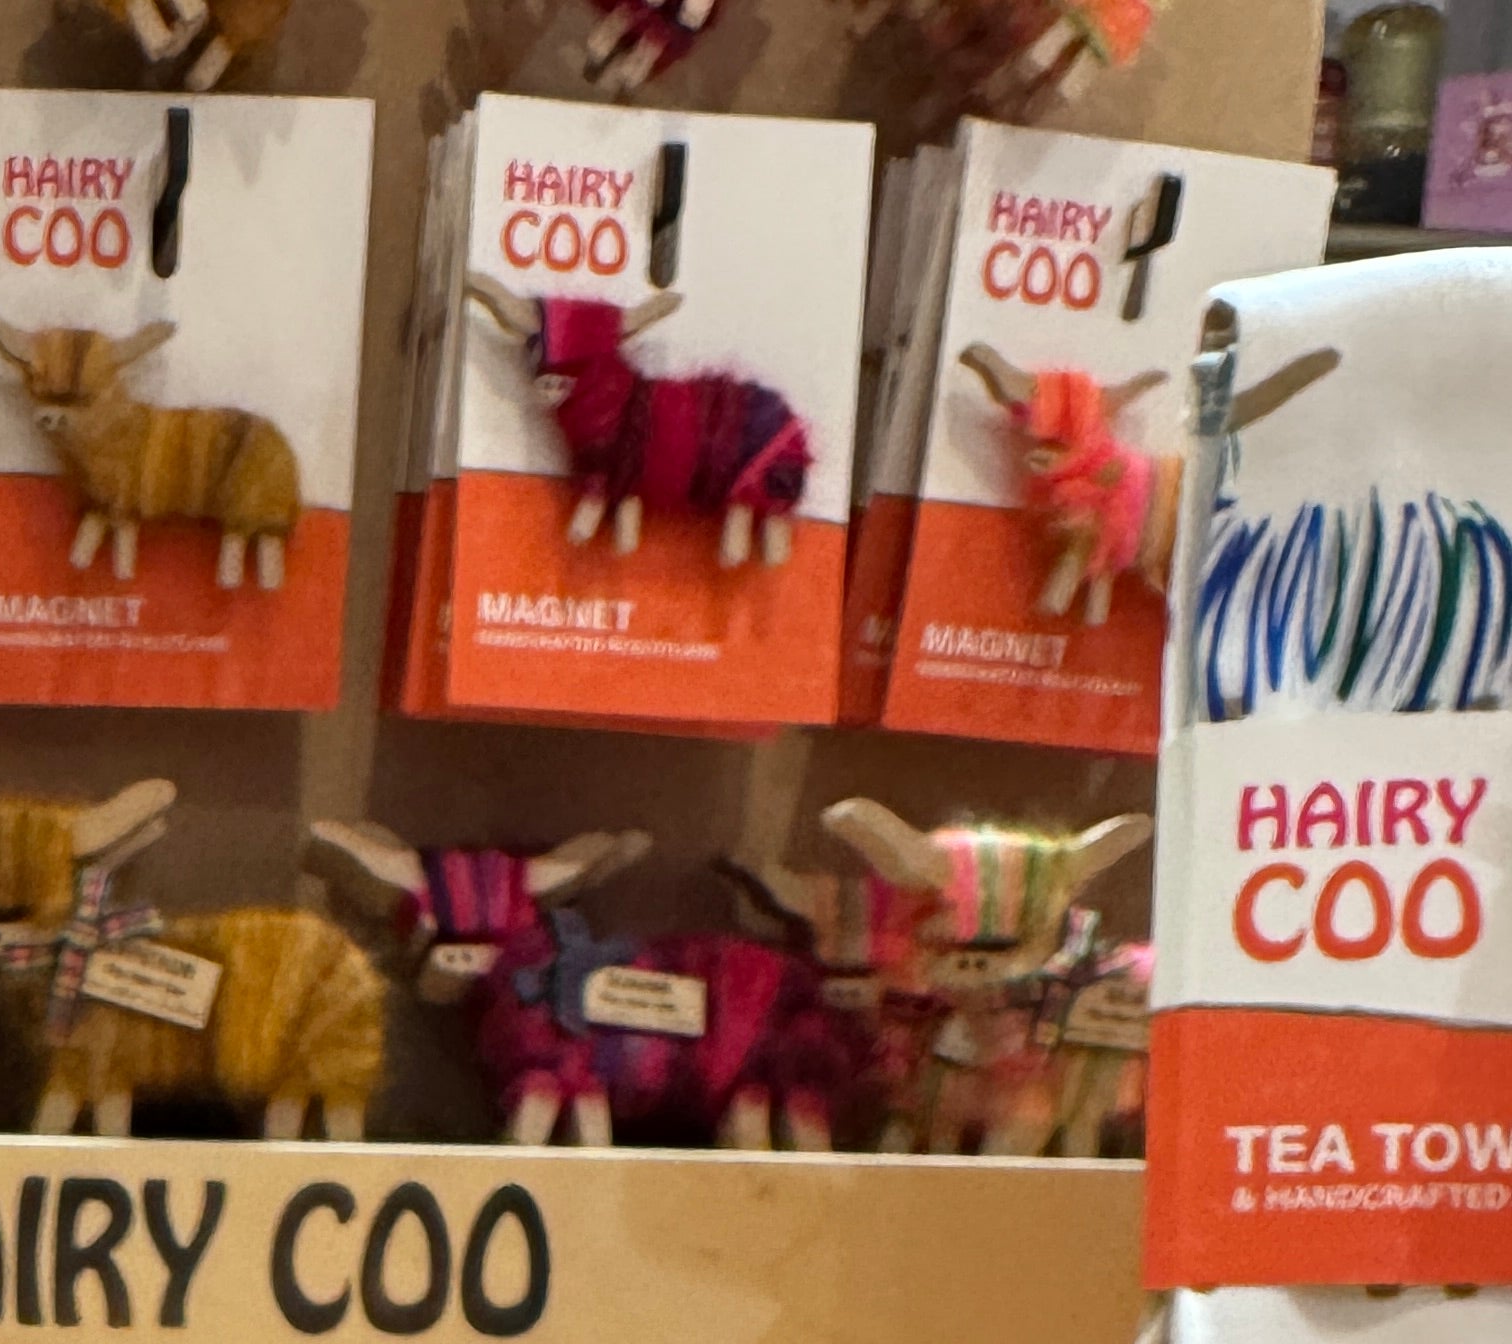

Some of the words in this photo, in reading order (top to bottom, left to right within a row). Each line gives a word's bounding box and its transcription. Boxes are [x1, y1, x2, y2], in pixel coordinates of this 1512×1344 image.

[3, 154, 134, 201] HAIRY
[503, 159, 634, 209] HAIRY
[3, 206, 131, 268] COO
[500, 211, 628, 275] COO
[989, 191, 1111, 245] HAIRY
[983, 241, 1102, 311] COO
[478, 593, 635, 631] MAGNET
[1237, 778, 1488, 850] HAIRY
[1233, 859, 1483, 961] COO
[1226, 1123, 1355, 1173] TEA
[1371, 1122, 1512, 1172] TOW
[1232, 1186, 1257, 1213] &
[1265, 1182, 1512, 1212] HANDCRAFTED
[271, 1181, 550, 1337] COO
